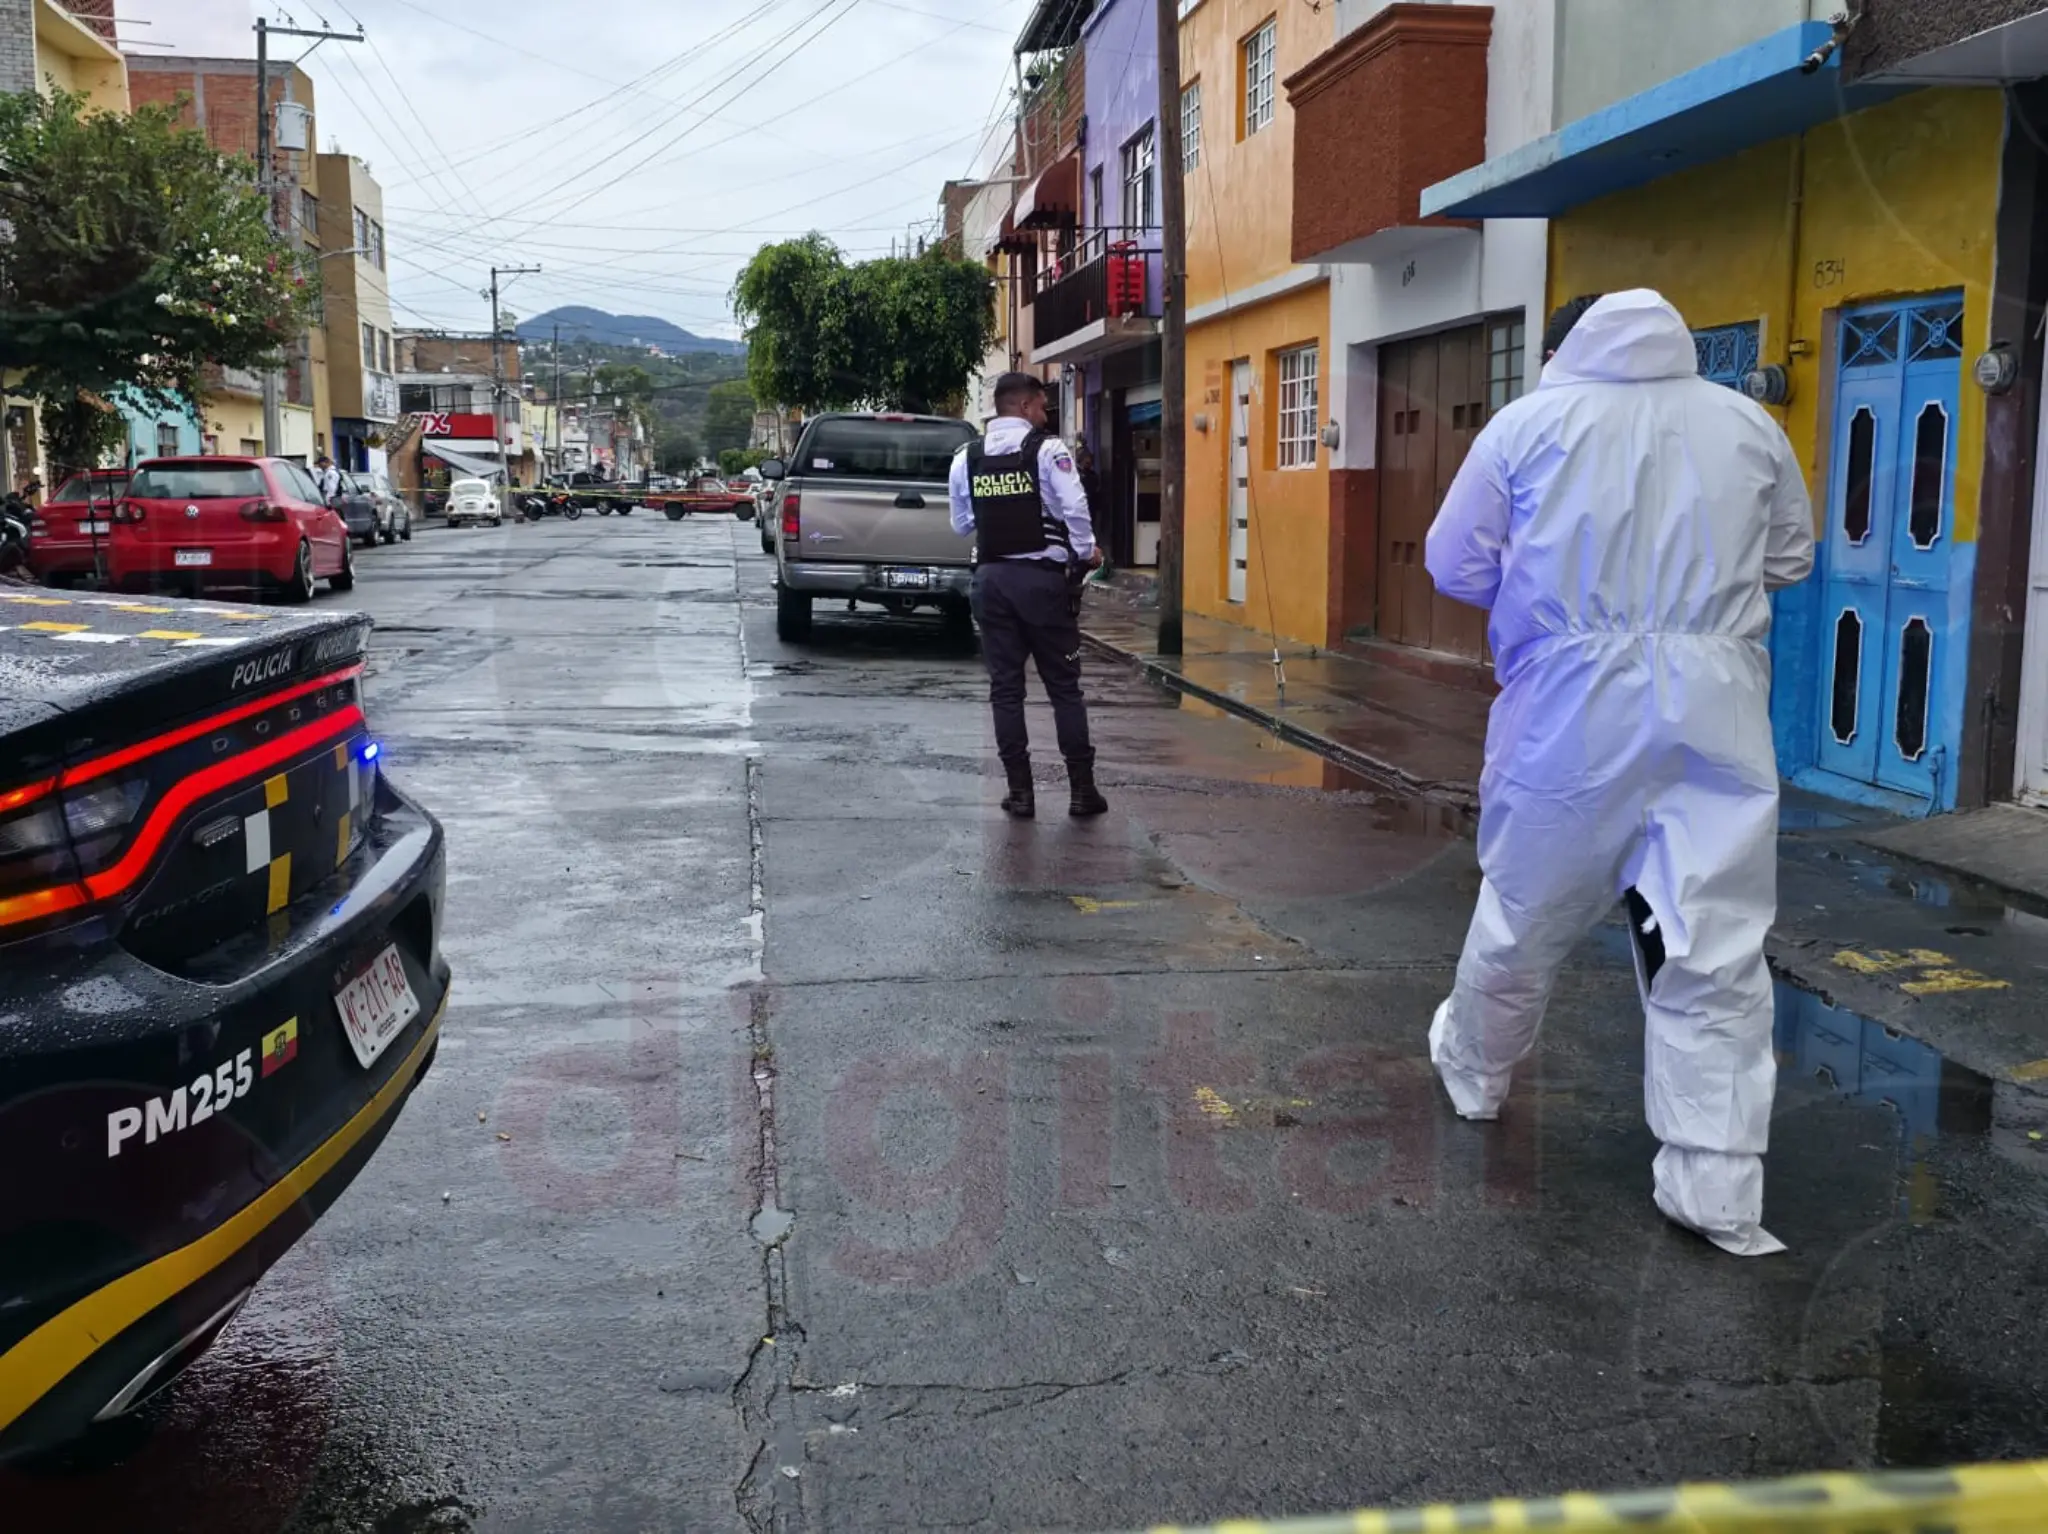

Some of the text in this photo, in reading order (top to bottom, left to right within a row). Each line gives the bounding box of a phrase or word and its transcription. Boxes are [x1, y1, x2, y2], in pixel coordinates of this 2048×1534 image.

[1813, 257, 1845, 289] 834
[973, 483, 1033, 498] MORELIA
[108, 1047, 253, 1159] PM255
